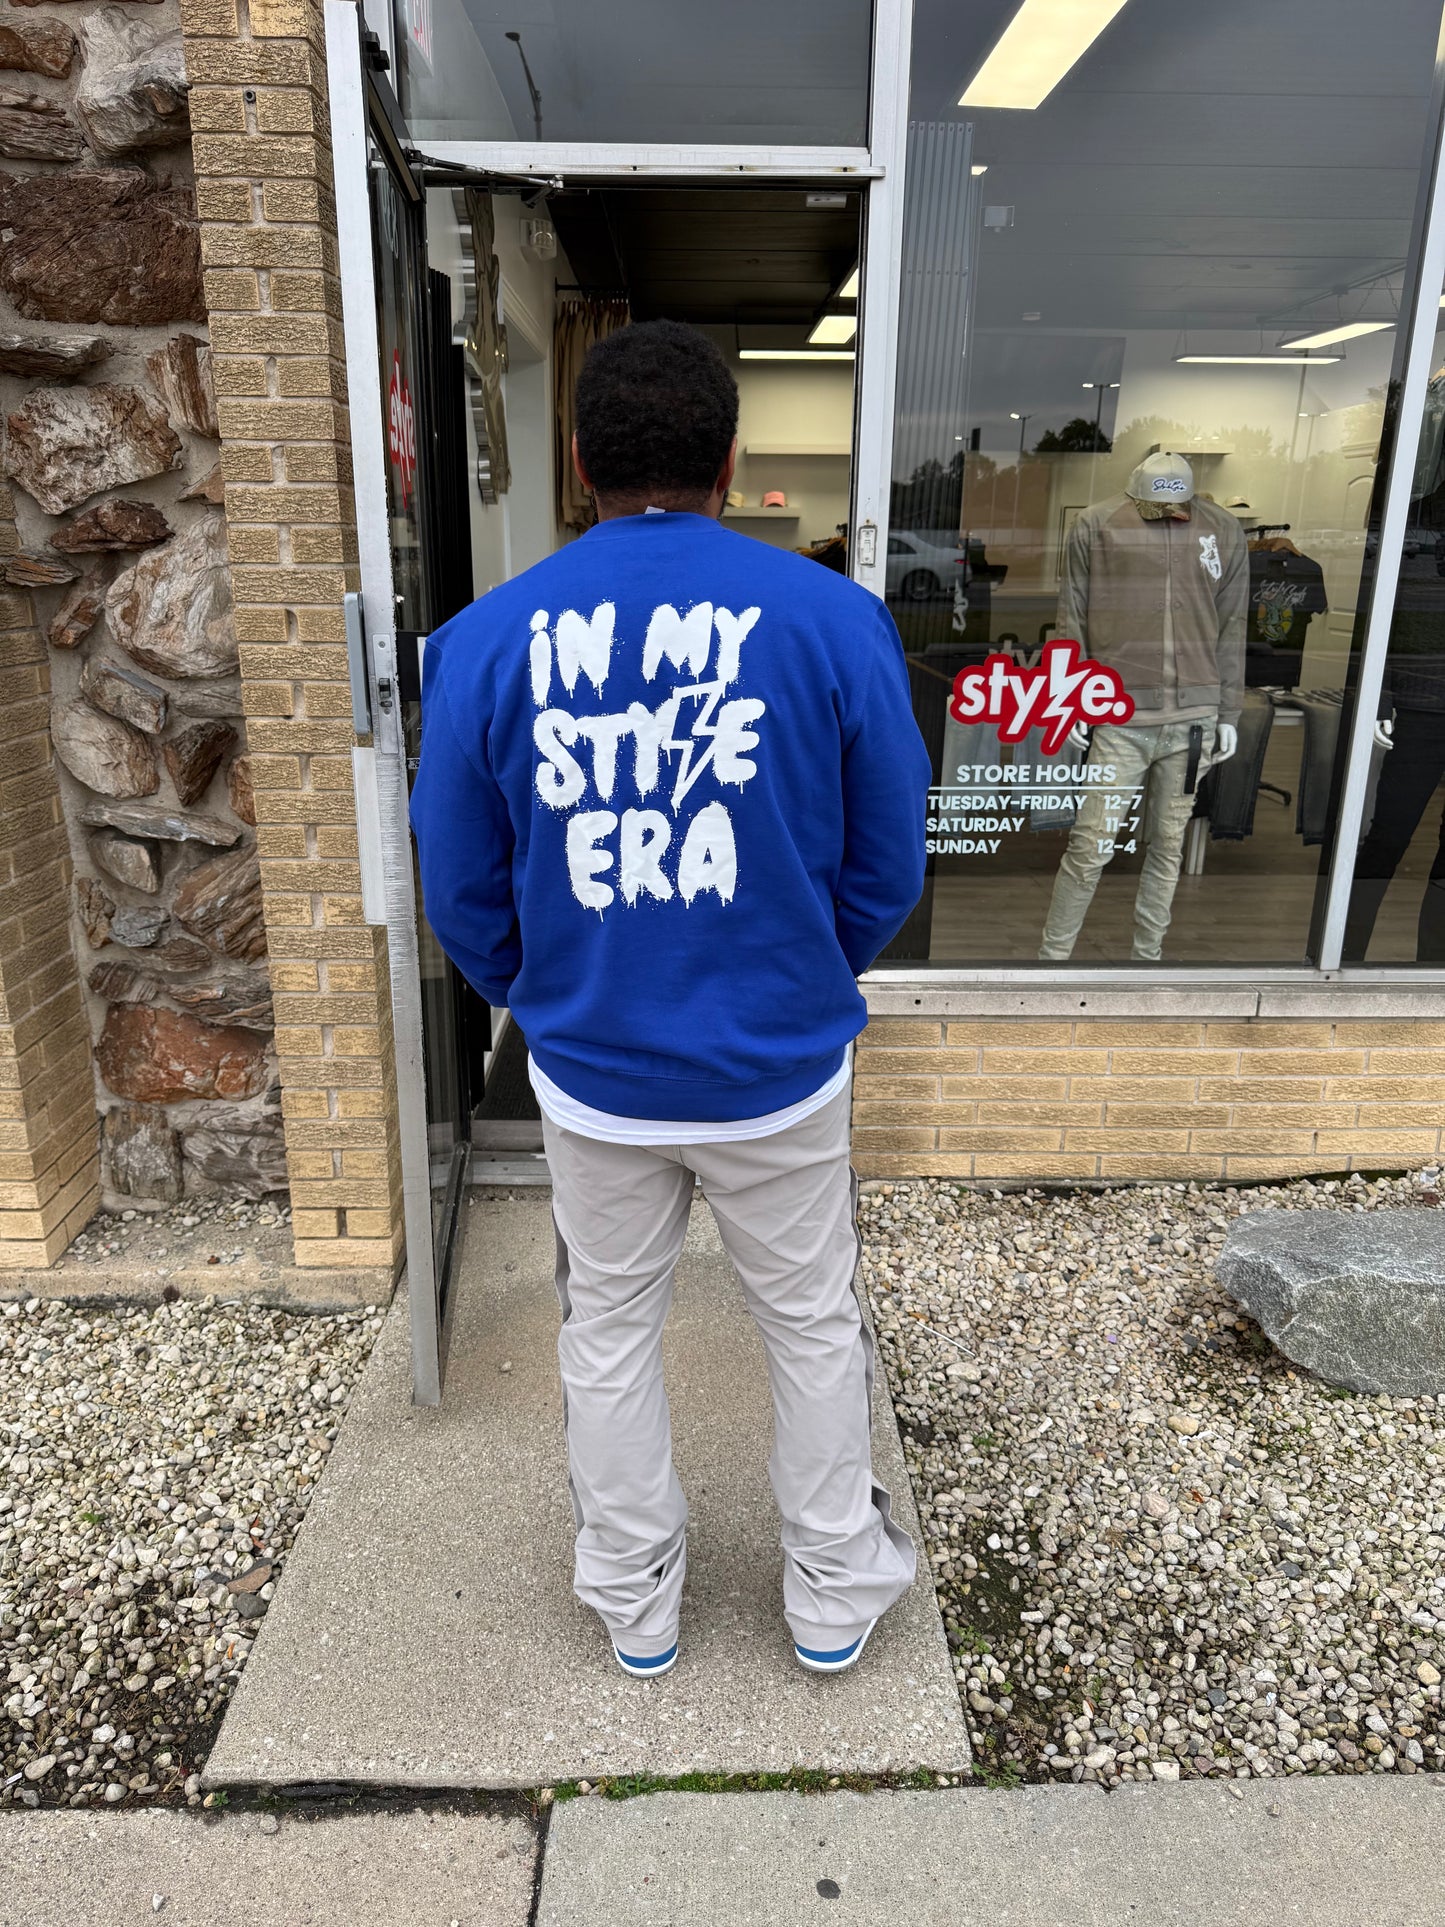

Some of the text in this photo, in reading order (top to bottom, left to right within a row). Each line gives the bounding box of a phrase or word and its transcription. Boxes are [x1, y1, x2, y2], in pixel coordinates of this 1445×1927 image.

[642, 600, 761, 688] MY
[956, 764, 1117, 783] STORE HOURS
[927, 795, 1142, 810] TUESDAY-FRIDAY 12-7
[926, 817, 1140, 832] SATURDAY 11-7
[925, 839, 1136, 854] SUNDAY 12-4
[566, 801, 737, 921] ERA
